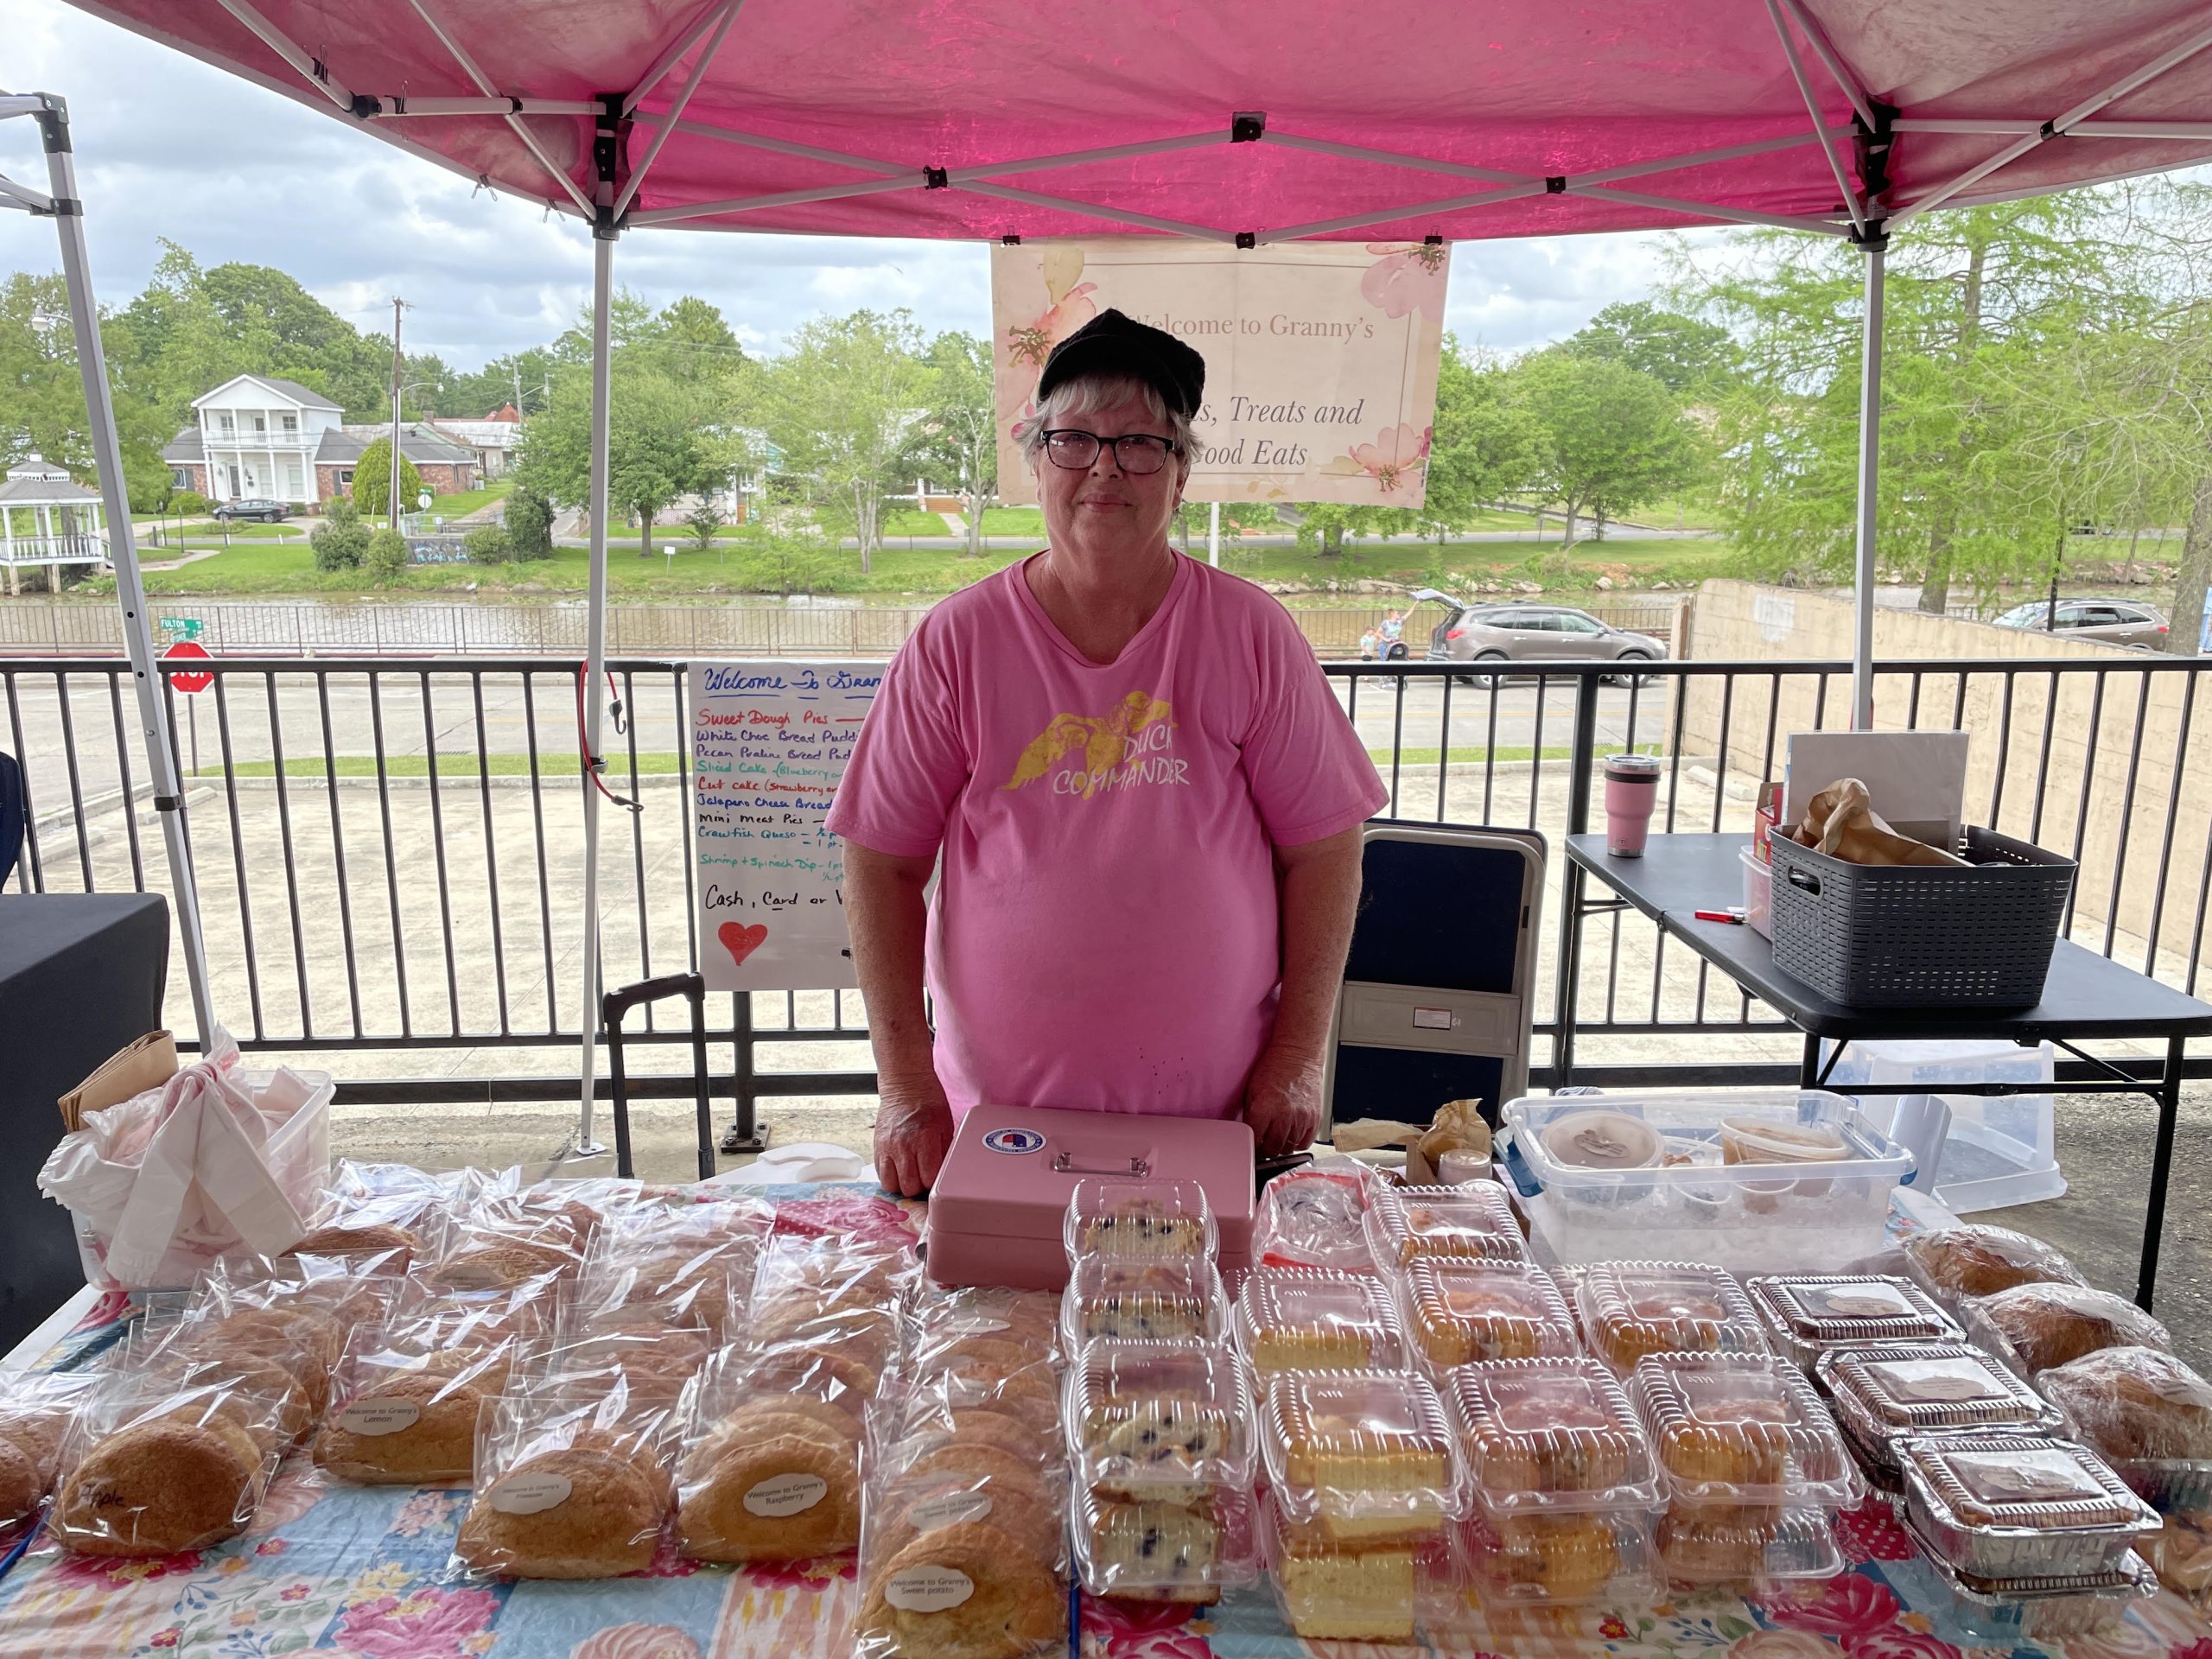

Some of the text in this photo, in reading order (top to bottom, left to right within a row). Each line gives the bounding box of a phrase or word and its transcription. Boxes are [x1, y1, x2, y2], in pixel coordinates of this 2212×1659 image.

[1241, 317, 1262, 335] to
[1270, 315, 1375, 345] Granny's
[1230, 395, 1306, 424] Treats
[1314, 398, 1364, 425] and
[1252, 441, 1307, 466] Eats
[161, 619, 186, 628] FULTON
[704, 667, 787, 690] Welcome
[696, 709, 829, 729] Sweet Dough Pies
[696, 730, 737, 742] White
[741, 729, 770, 741] Choc
[779, 730, 816, 744] Bread
[1122, 724, 1173, 763] DUCK
[696, 744, 734, 759] Pecan
[696, 760, 732, 773] Sliced
[739, 761, 768, 774] Cake
[1052, 756, 1191, 795] COMMANDER
[698, 776, 726, 791] Cut
[696, 793, 832, 810] Jalapeno Cheese Bread
[783, 813, 803, 824] Pies
[698, 825, 755, 838] Crawfish
[760, 830, 797, 839] Queso
[700, 854, 738, 868] Shrimp
[750, 855, 794, 870] Spinach
[762, 891, 798, 906] Card
[80, 1483, 125, 1509] Apple
[747, 1489, 781, 1499] Welcome
[793, 1481, 823, 1491] Granny's
[766, 1493, 804, 1505] Raspberry
[891, 1579, 925, 1587] Welcome
[938, 1576, 970, 1587] Granny's
[901, 1586, 955, 1596] Sweet potato
